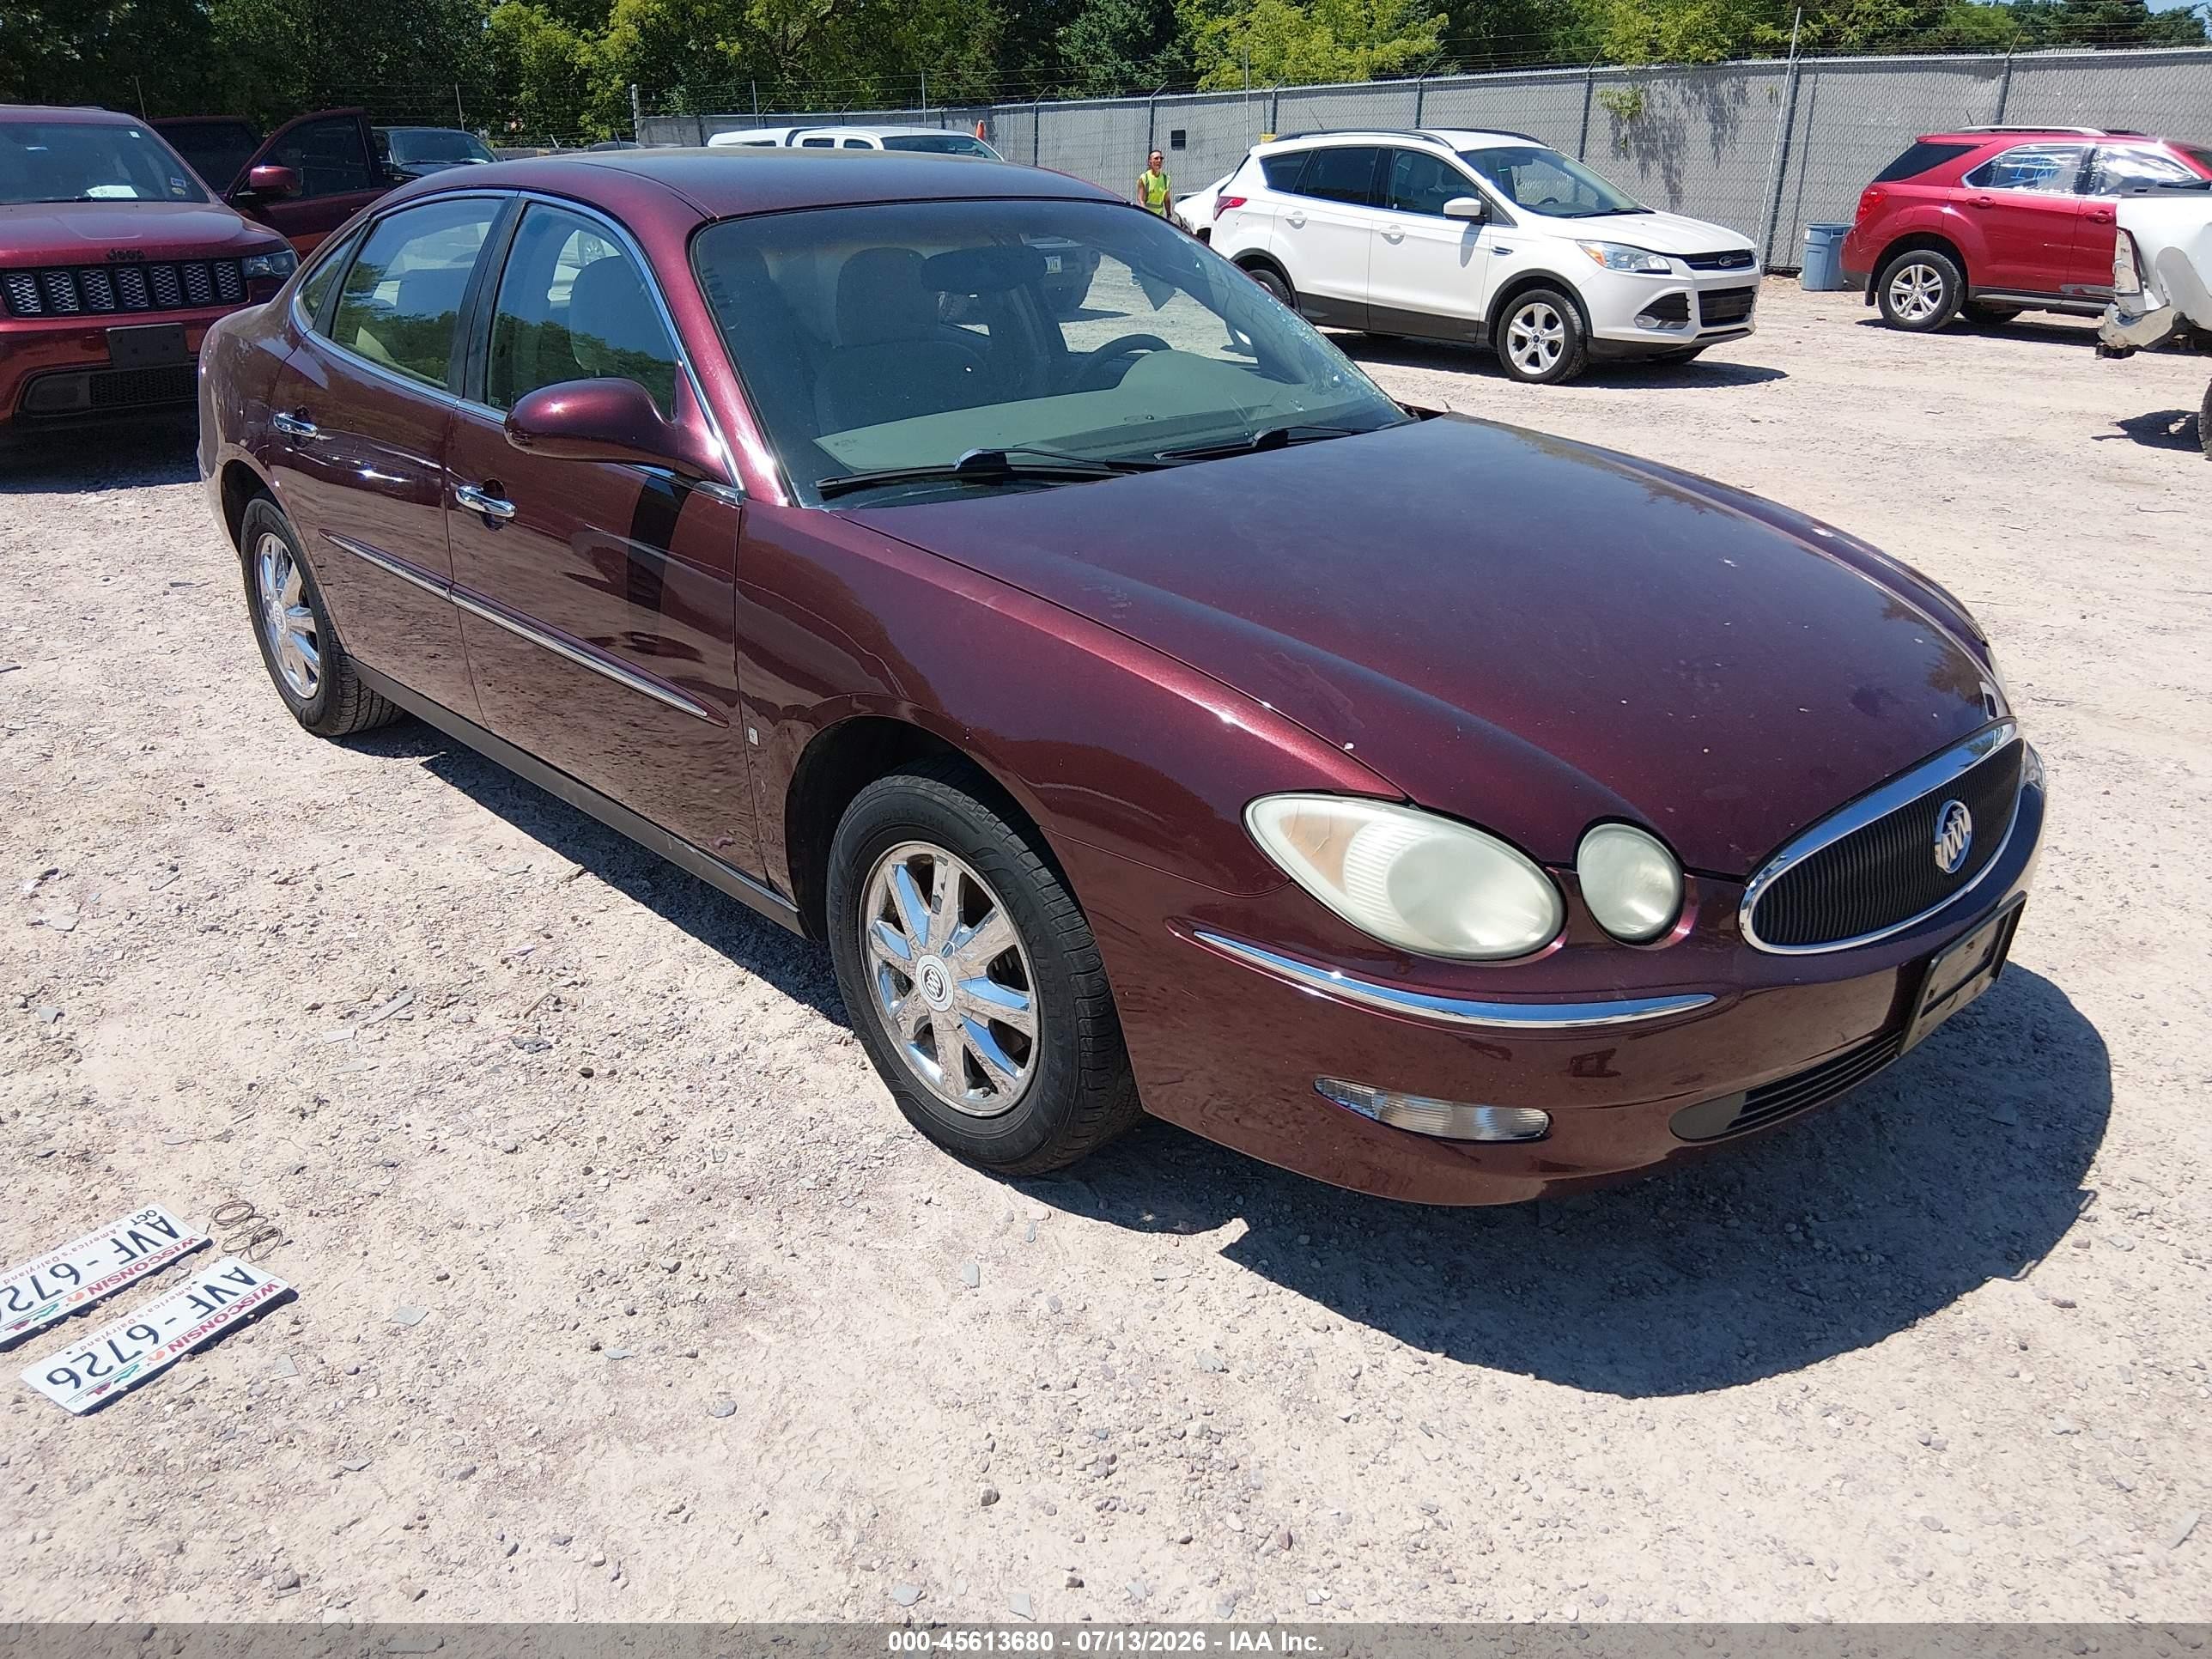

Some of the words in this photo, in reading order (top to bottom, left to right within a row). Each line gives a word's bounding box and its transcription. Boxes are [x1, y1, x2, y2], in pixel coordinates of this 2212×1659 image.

[131, 1209, 158, 1226] OCT
[61, 1228, 117, 1257] America's
[3, 1255, 60, 1285] Dairyland
[87, 1237, 200, 1296] WISCONSIN
[137, 1285, 192, 1319] America's
[167, 1281, 281, 1353] WISCONSIN
[79, 1318, 137, 1352] Dairyland
